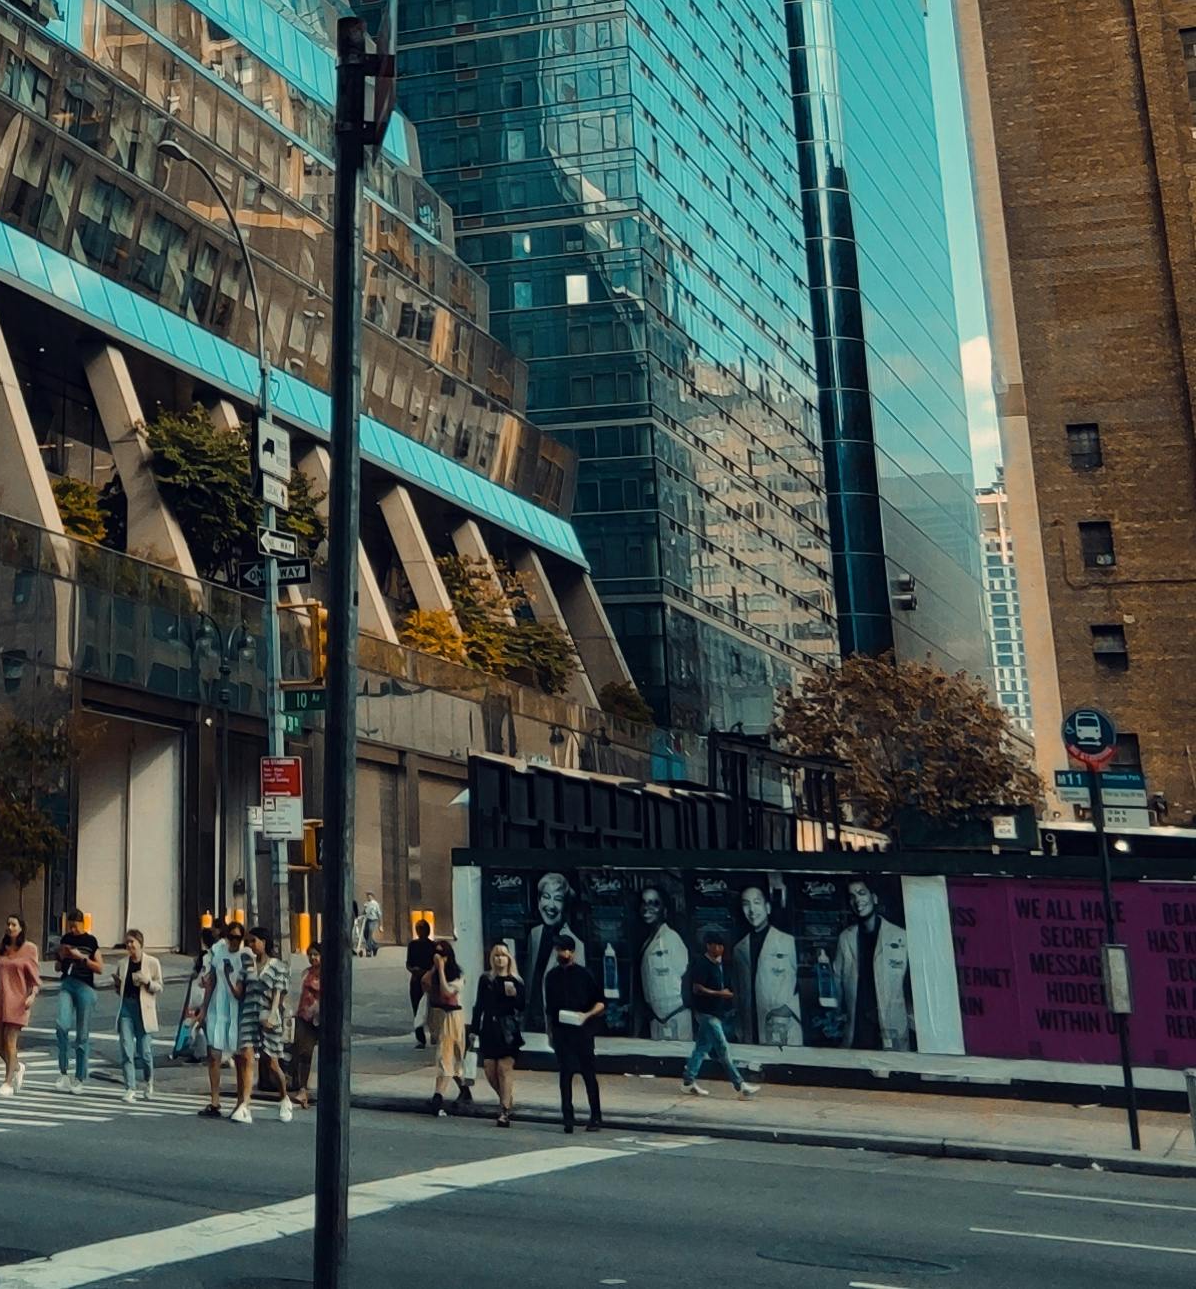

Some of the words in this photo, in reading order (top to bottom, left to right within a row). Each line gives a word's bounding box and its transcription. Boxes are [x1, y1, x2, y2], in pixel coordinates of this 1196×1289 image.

[280, 567, 301, 578] WAY
[296, 692, 308, 709] 10
[1057, 773, 1083, 785] M11
[1015, 897, 1040, 920] WE
[1046, 898, 1076, 922] ALL
[1147, 928, 1180, 953] HAS
[1165, 987, 1188, 1011] AN
[1036, 1008, 1101, 1034] WITHIN
